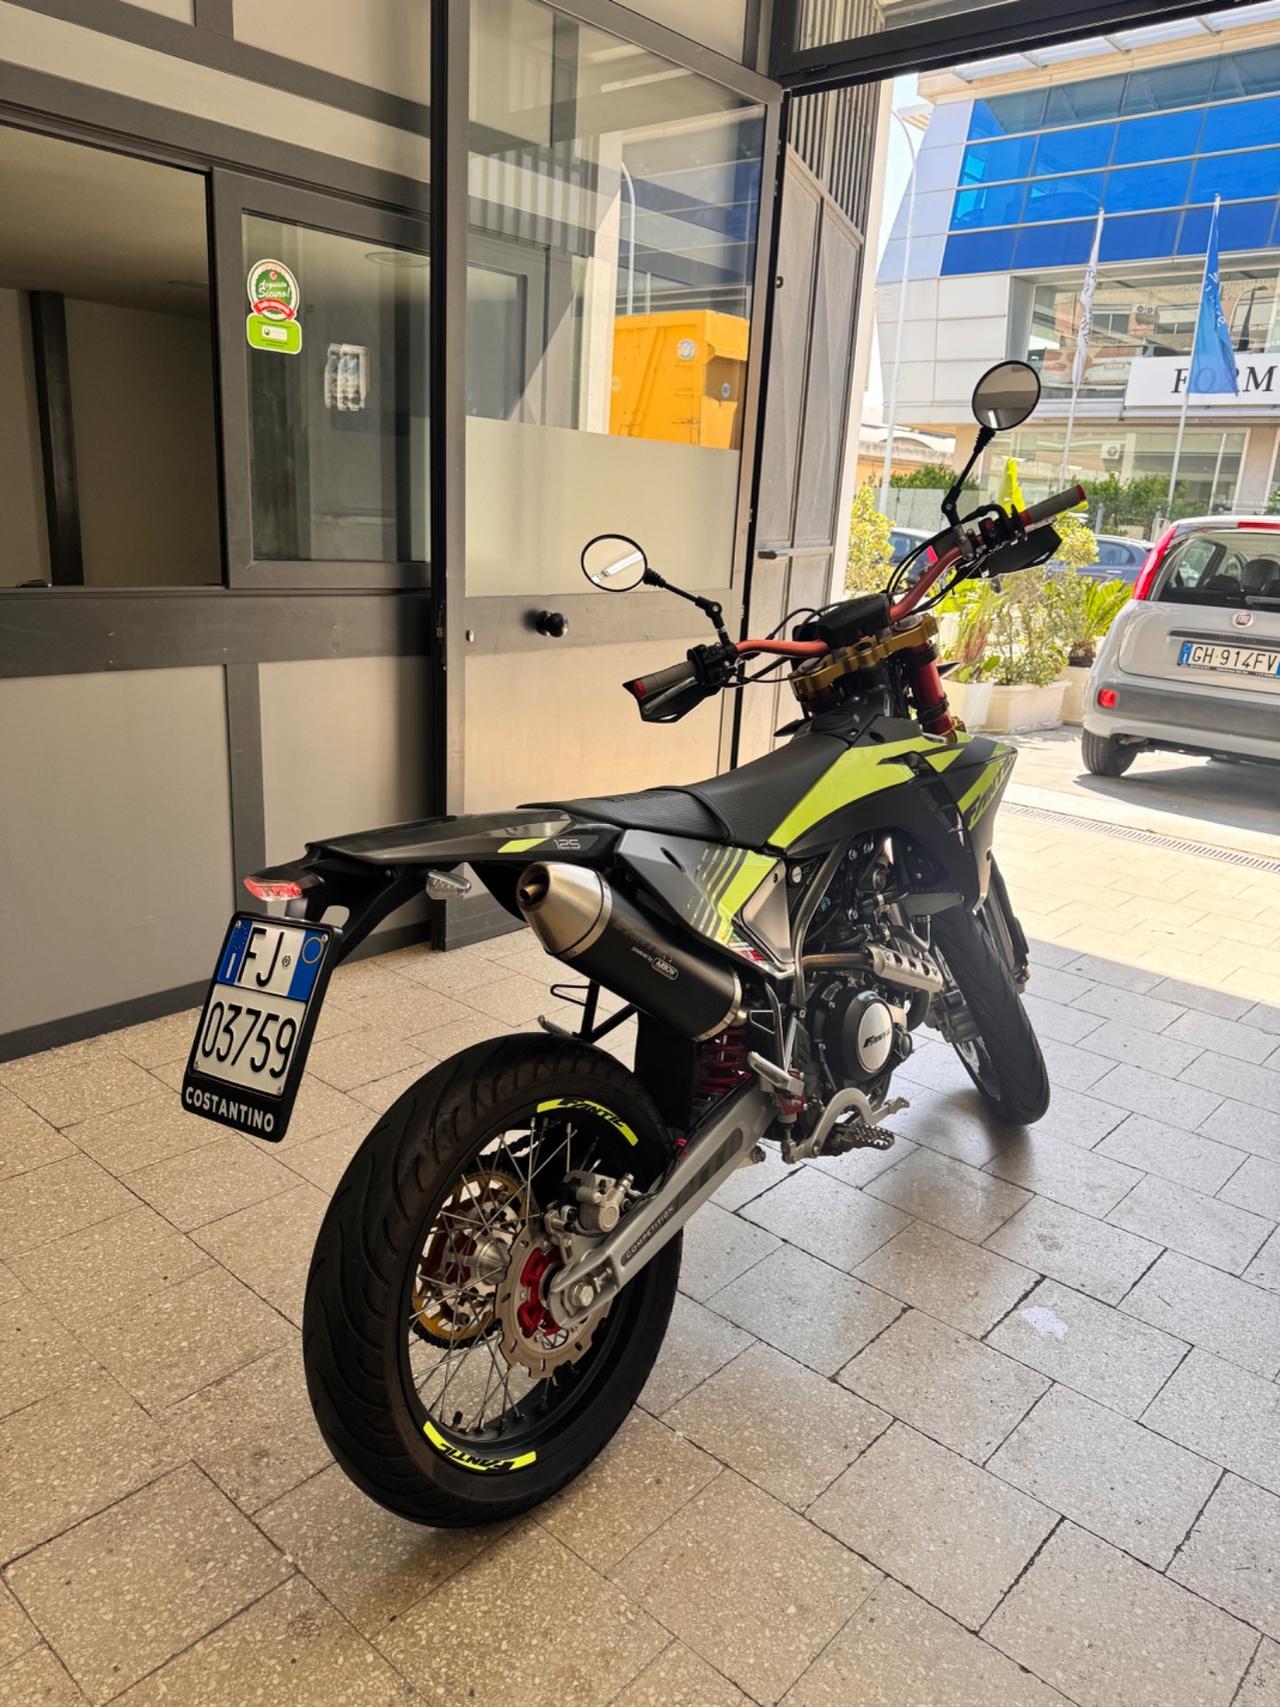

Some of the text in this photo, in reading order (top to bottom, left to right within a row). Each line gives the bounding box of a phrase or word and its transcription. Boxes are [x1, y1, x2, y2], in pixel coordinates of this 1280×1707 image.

[1170, 365, 1280, 394] FOM
[1193, 646, 1278, 671] GH 914FV
[552, 838, 582, 850] 125
[237, 926, 286, 987] FJ
[201, 1000, 297, 1079] 03759
[185, 1086, 275, 1133] COSTANTINO
[440, 1443, 517, 1475] FANTIC
